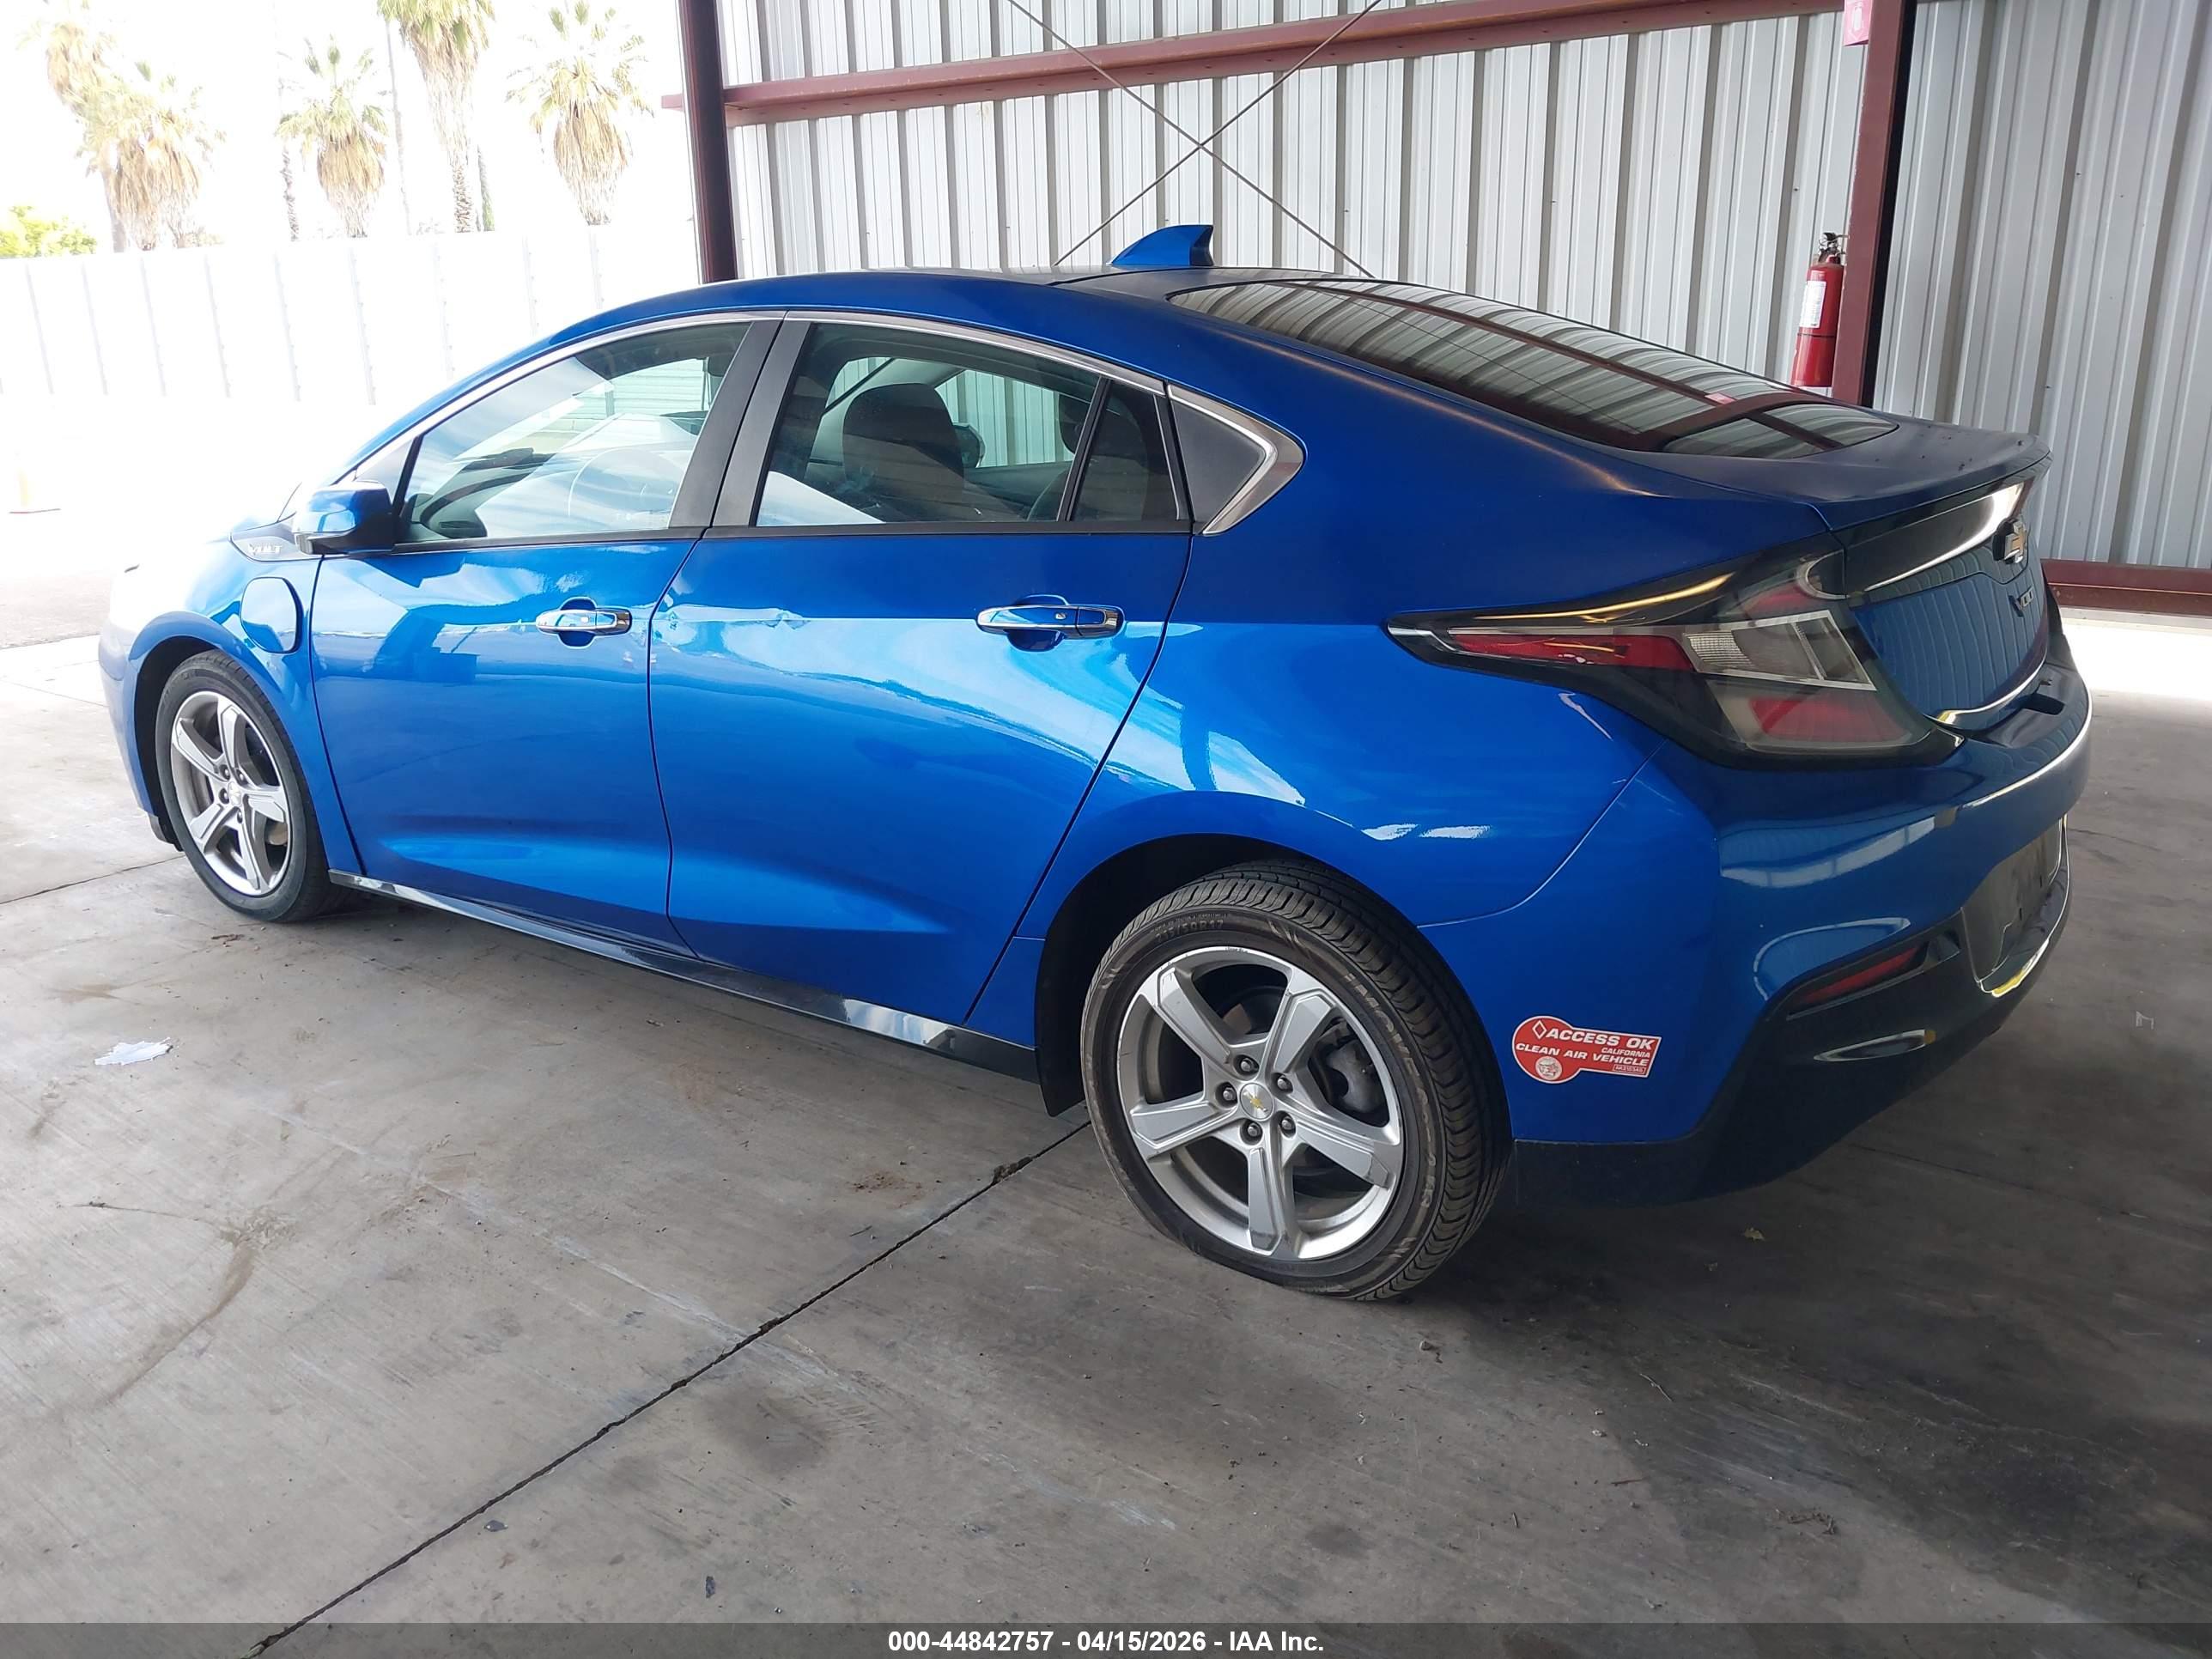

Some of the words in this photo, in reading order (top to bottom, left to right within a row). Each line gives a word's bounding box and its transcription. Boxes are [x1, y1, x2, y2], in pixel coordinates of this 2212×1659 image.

[1546, 1028, 1620, 1047] ACCESS
[1626, 1037, 1656, 1050] OK
[1516, 1042, 1560, 1056] CLEAN
[1563, 1049, 1588, 1060] AIR
[1593, 1053, 1650, 1066] VEHICLE
[1601, 1047, 1650, 1058] CALIFORNIA
